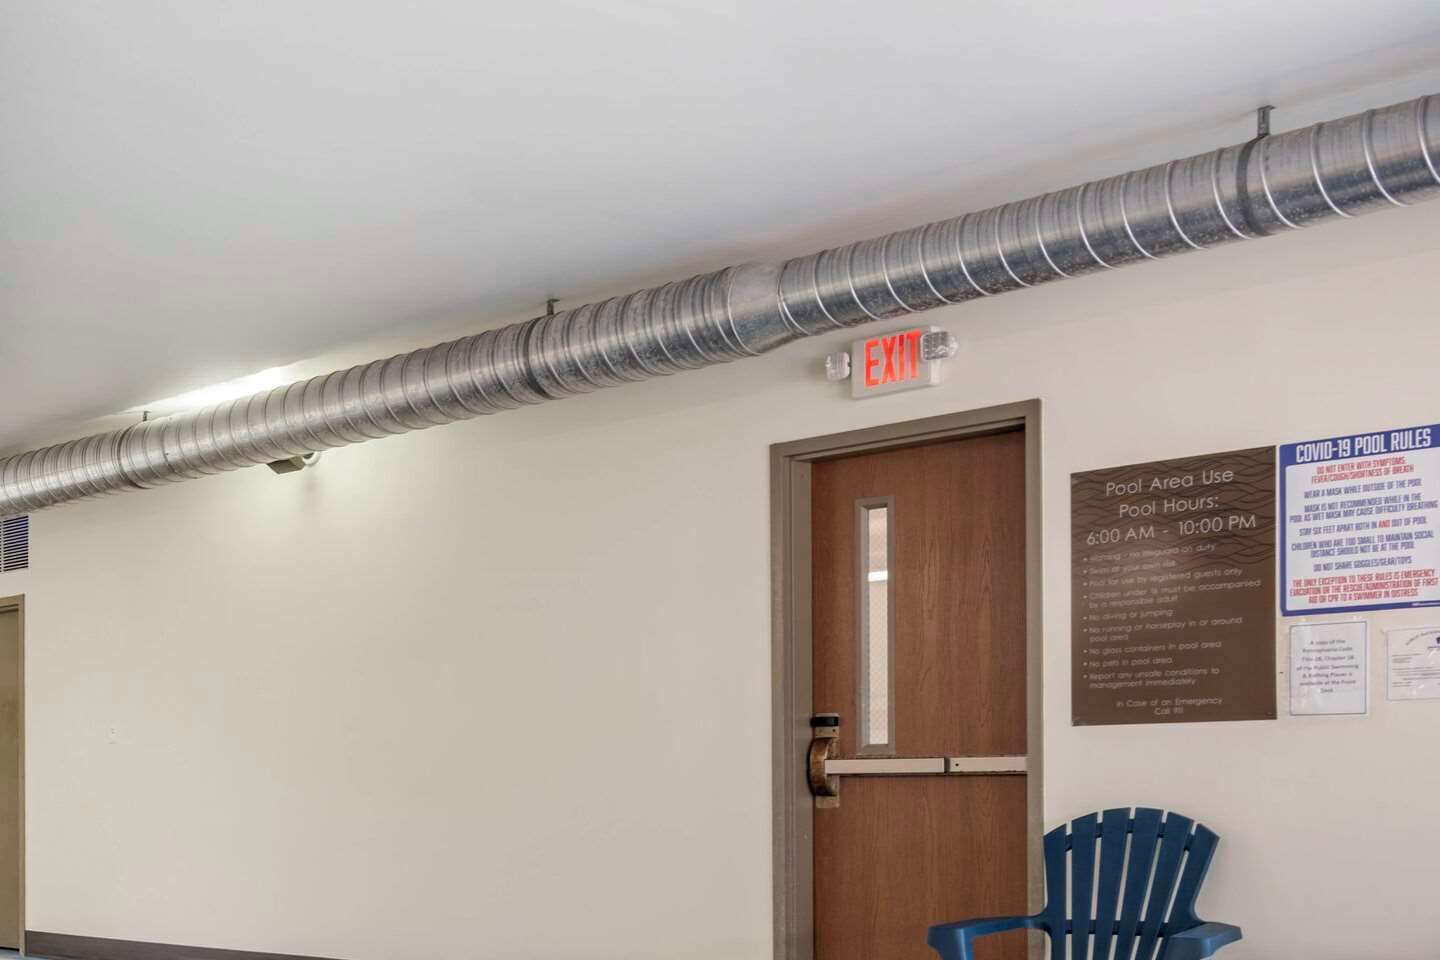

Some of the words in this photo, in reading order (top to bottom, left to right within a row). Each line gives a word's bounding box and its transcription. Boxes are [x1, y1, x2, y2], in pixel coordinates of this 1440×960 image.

[865, 329, 921, 388] EXIT
[1295, 438, 1350, 463] COVID-19
[1354, 433, 1387, 455] POOL
[1390, 427, 1431, 451] RULES
[1106, 478, 1142, 497] Pool
[1148, 471, 1192, 491] Area
[1202, 465, 1233, 484] Use
[1119, 500, 1155, 518] Pool
[1163, 492, 1219, 513] Hours:
[1086, 528, 1119, 545] 6:00
[1124, 524, 1154, 541] AM
[1178, 516, 1222, 535] 10:00
[1228, 513, 1256, 530] PM
